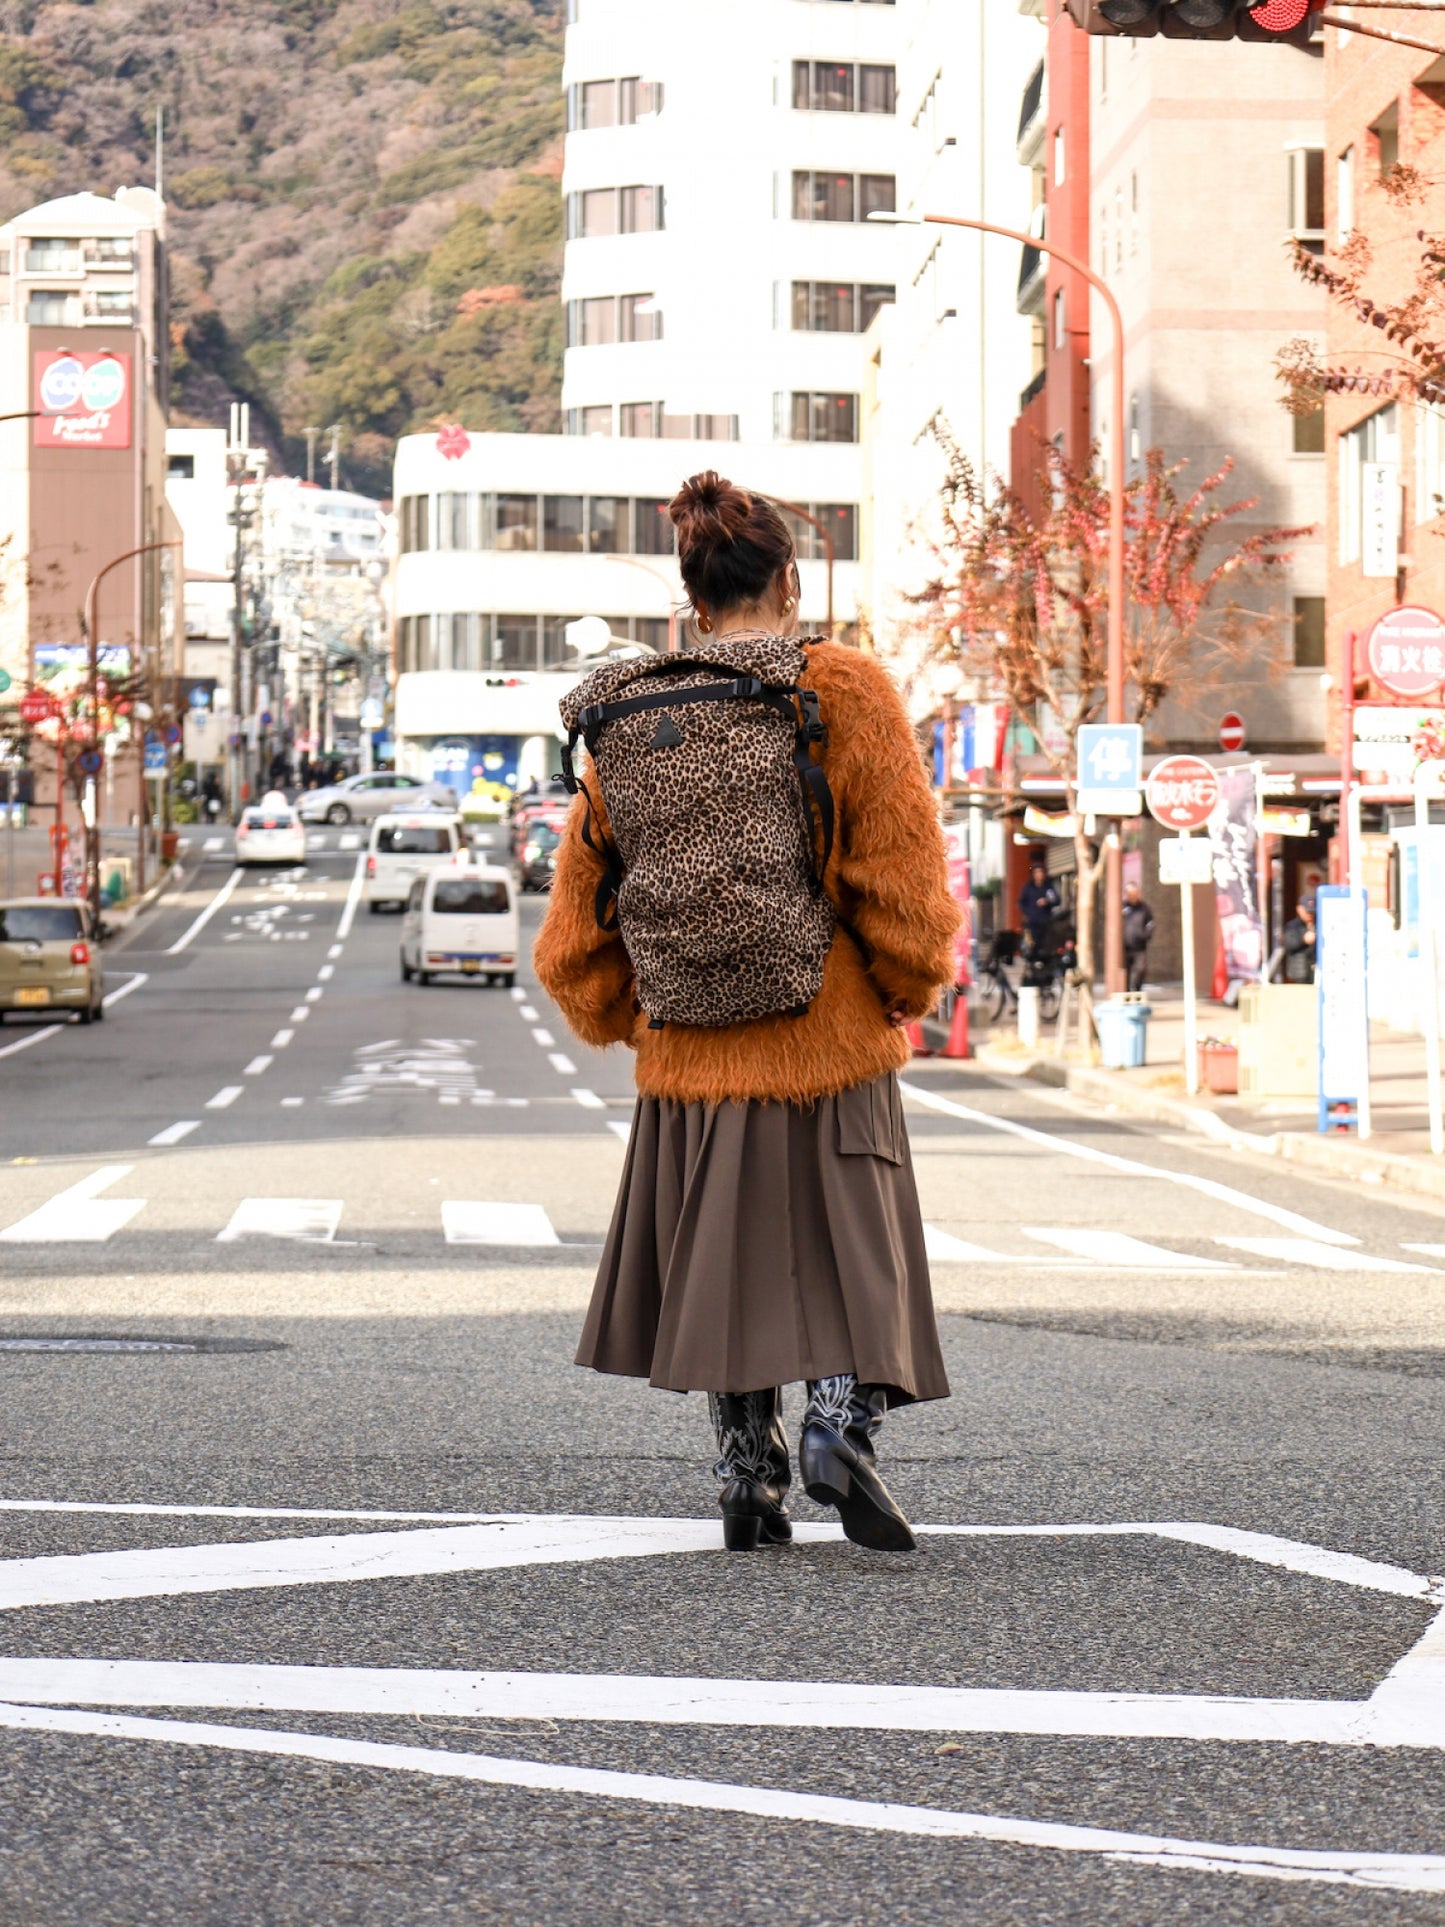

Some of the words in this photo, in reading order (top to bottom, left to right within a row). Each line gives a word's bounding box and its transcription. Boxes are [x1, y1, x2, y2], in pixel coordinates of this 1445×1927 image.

[1379, 644, 1444, 673] 消火栓
[1087, 735, 1133, 782] 停
